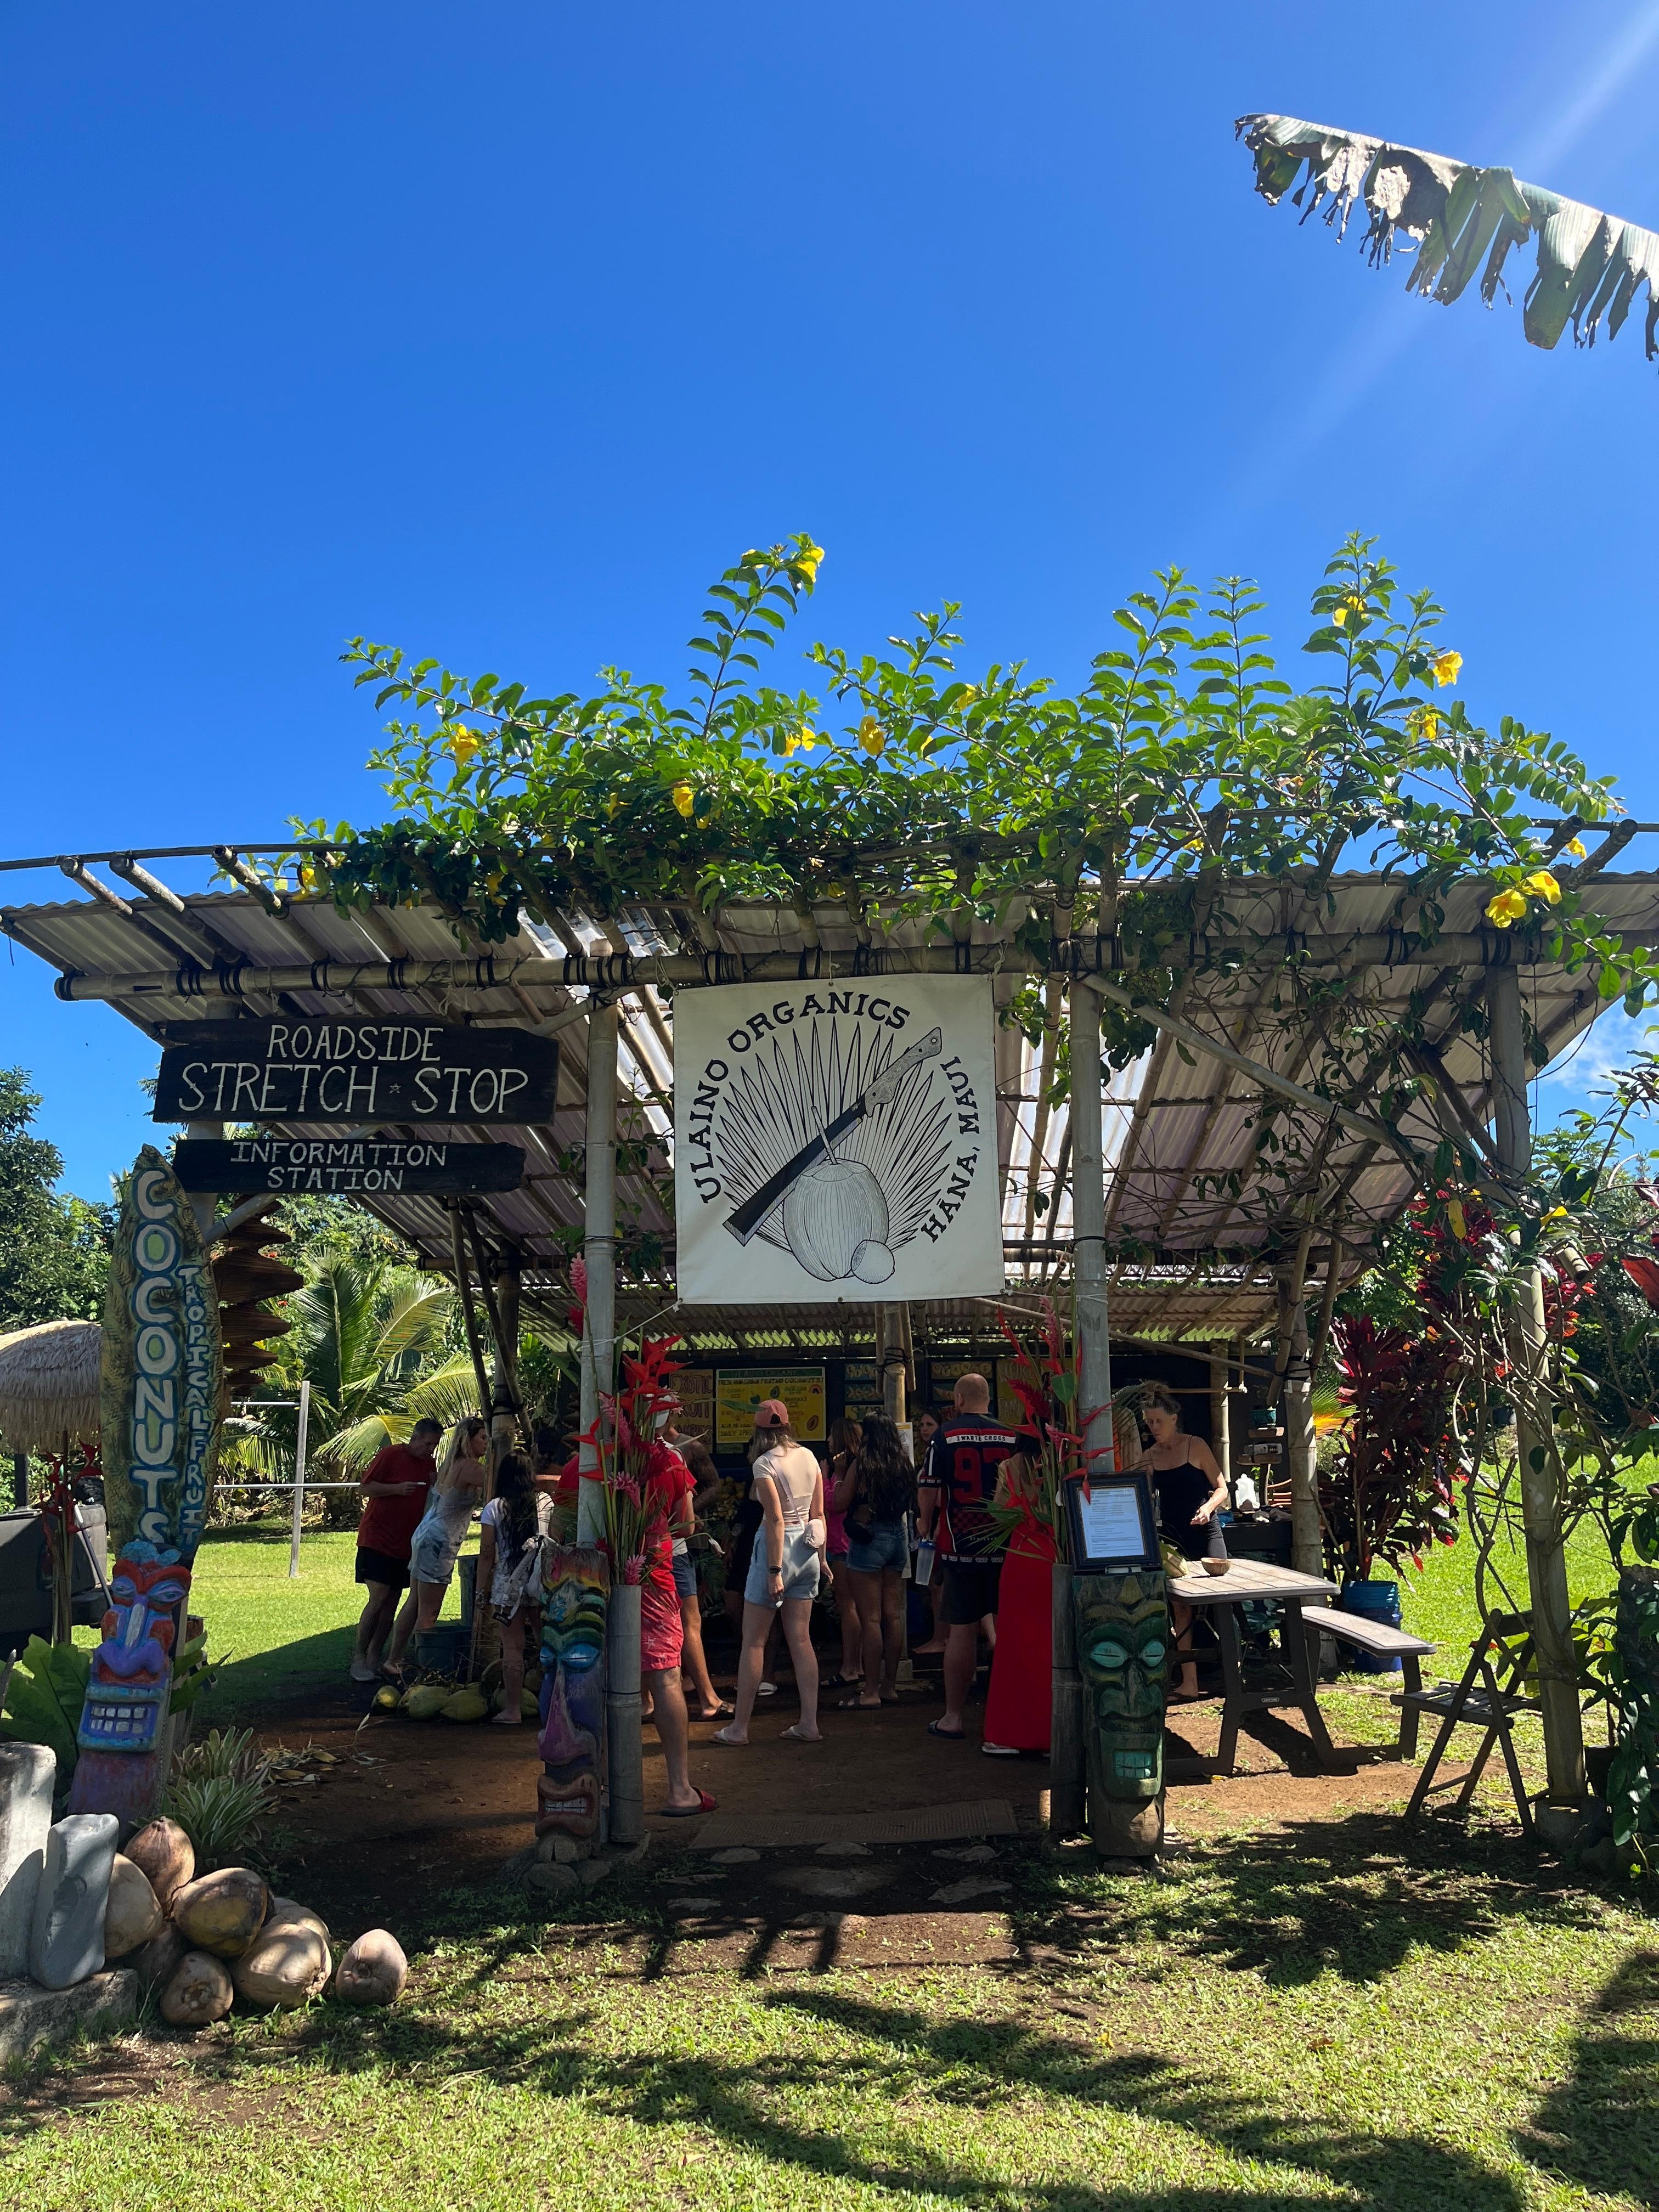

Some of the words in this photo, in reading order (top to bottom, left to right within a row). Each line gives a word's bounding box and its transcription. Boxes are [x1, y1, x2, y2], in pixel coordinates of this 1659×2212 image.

[267, 1024, 444, 1062] ROADSIDE
[178, 1062, 379, 1113] STRETCH
[411, 1067, 529, 1114] STOP
[688, 1058, 729, 1204] ULAINO
[727, 991, 911, 1053] ORGANICS
[940, 1056, 980, 1135] MAUI
[230, 1141, 447, 1166] INFORMATION
[267, 1166, 404, 1190] STATION
[132, 1170, 177, 1543] COCONUTS
[670, 1374, 713, 1395] EXOTIC
[677, 1398, 710, 1418] RUIT
